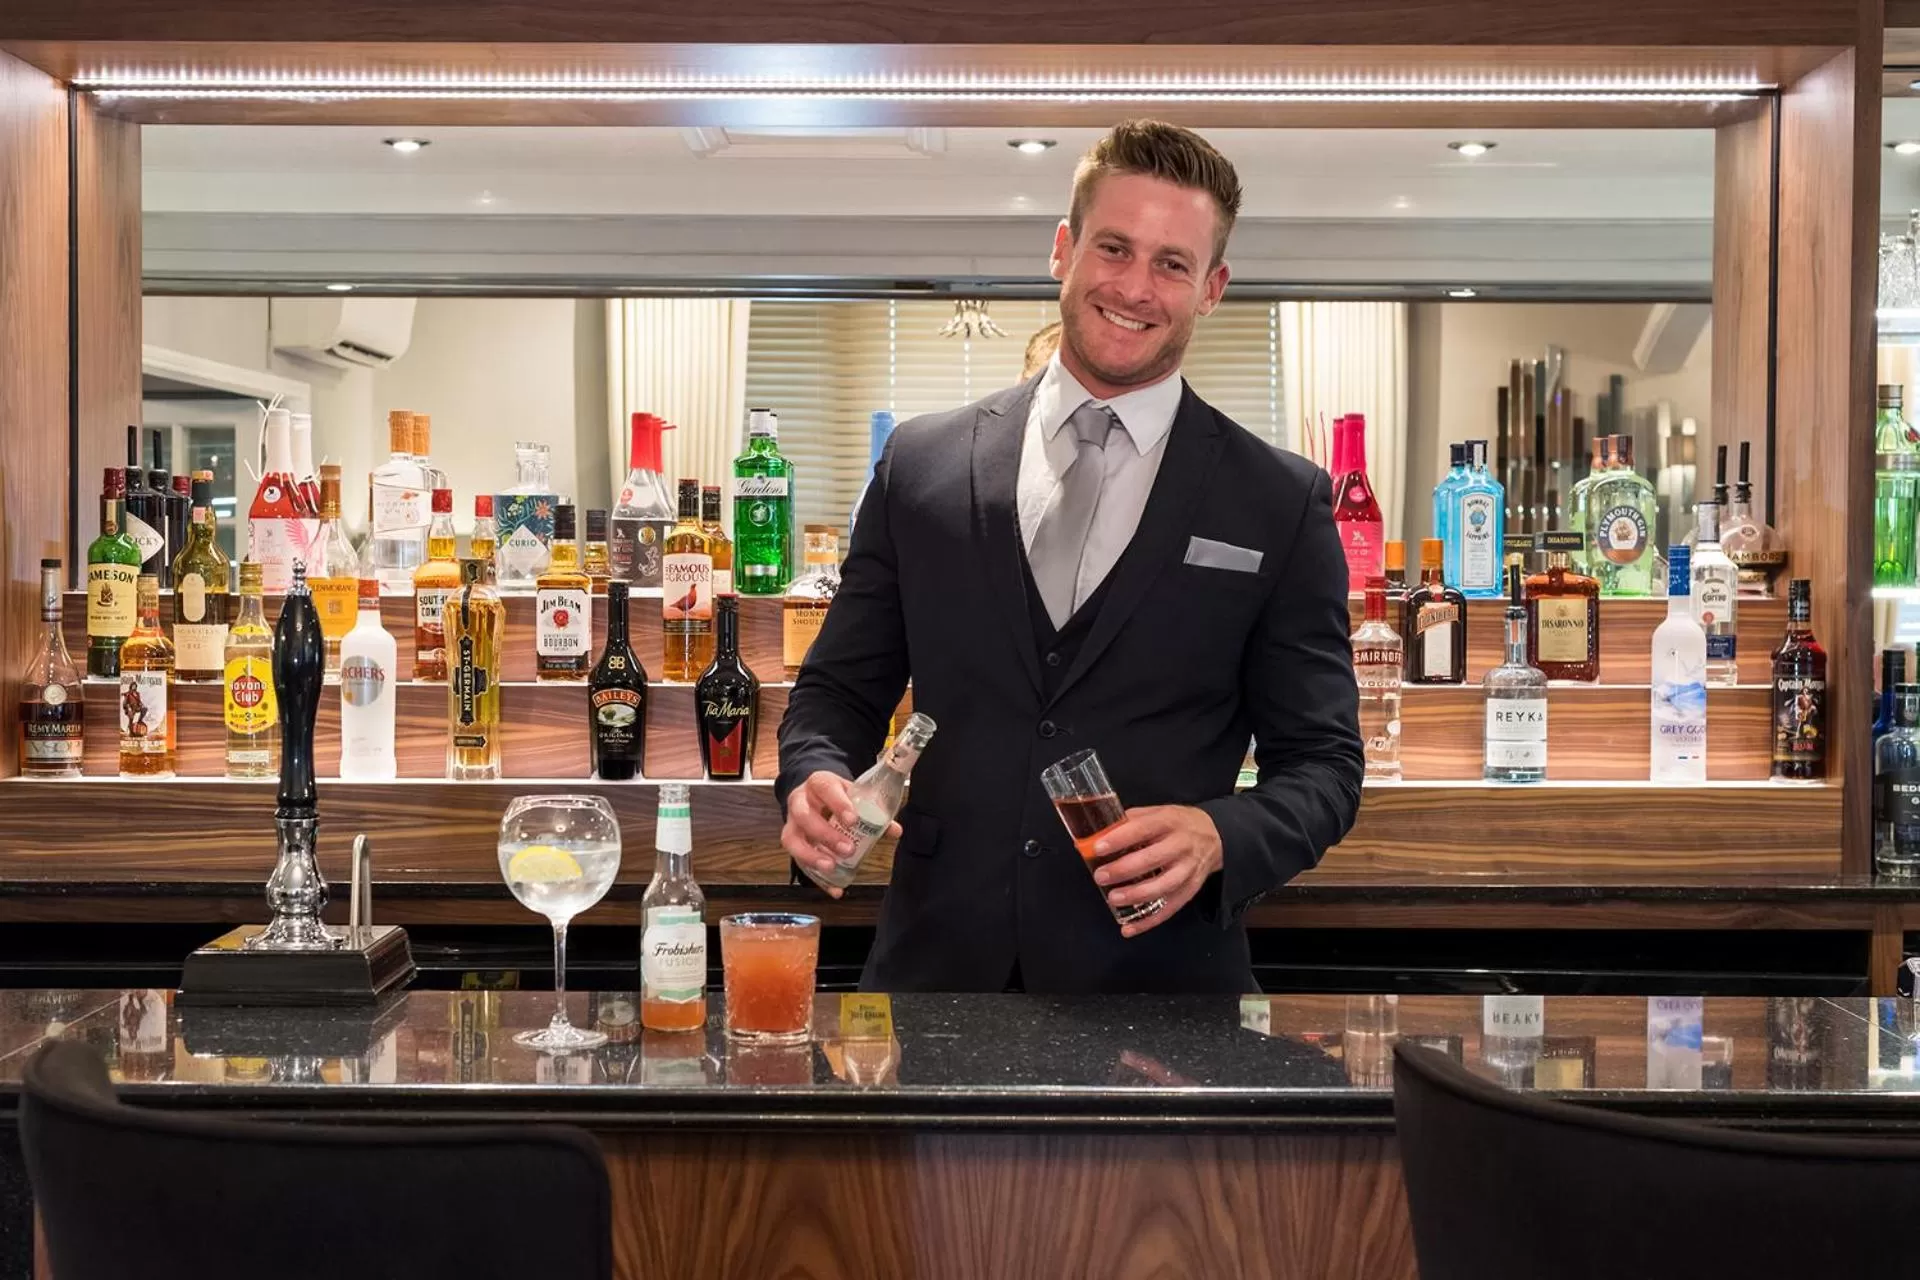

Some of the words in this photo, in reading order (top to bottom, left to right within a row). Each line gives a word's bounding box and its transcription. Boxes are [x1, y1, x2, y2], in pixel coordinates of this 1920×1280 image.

[1600, 507, 1640, 537] PLYMOUTH
[1637, 518, 1646, 537] GIN
[668, 564, 709, 573] FAMOUS
[541, 599, 556, 614] JIM
[557, 596, 581, 614] BEAM
[1542, 619, 1585, 628] DISARONNO
[544, 638, 578, 647] BOURBON
[1354, 651, 1402, 662] SMIRNOFF
[1778, 679, 1803, 692] Captain
[235, 691, 260, 702] Club
[595, 690, 638, 704] BAILEYS
[702, 700, 719, 717] Tia
[717, 700, 750, 717] Maria
[1495, 711, 1543, 722] REYKA
[1660, 724, 1683, 735] GREY
[1893, 784, 1920, 792] BED
